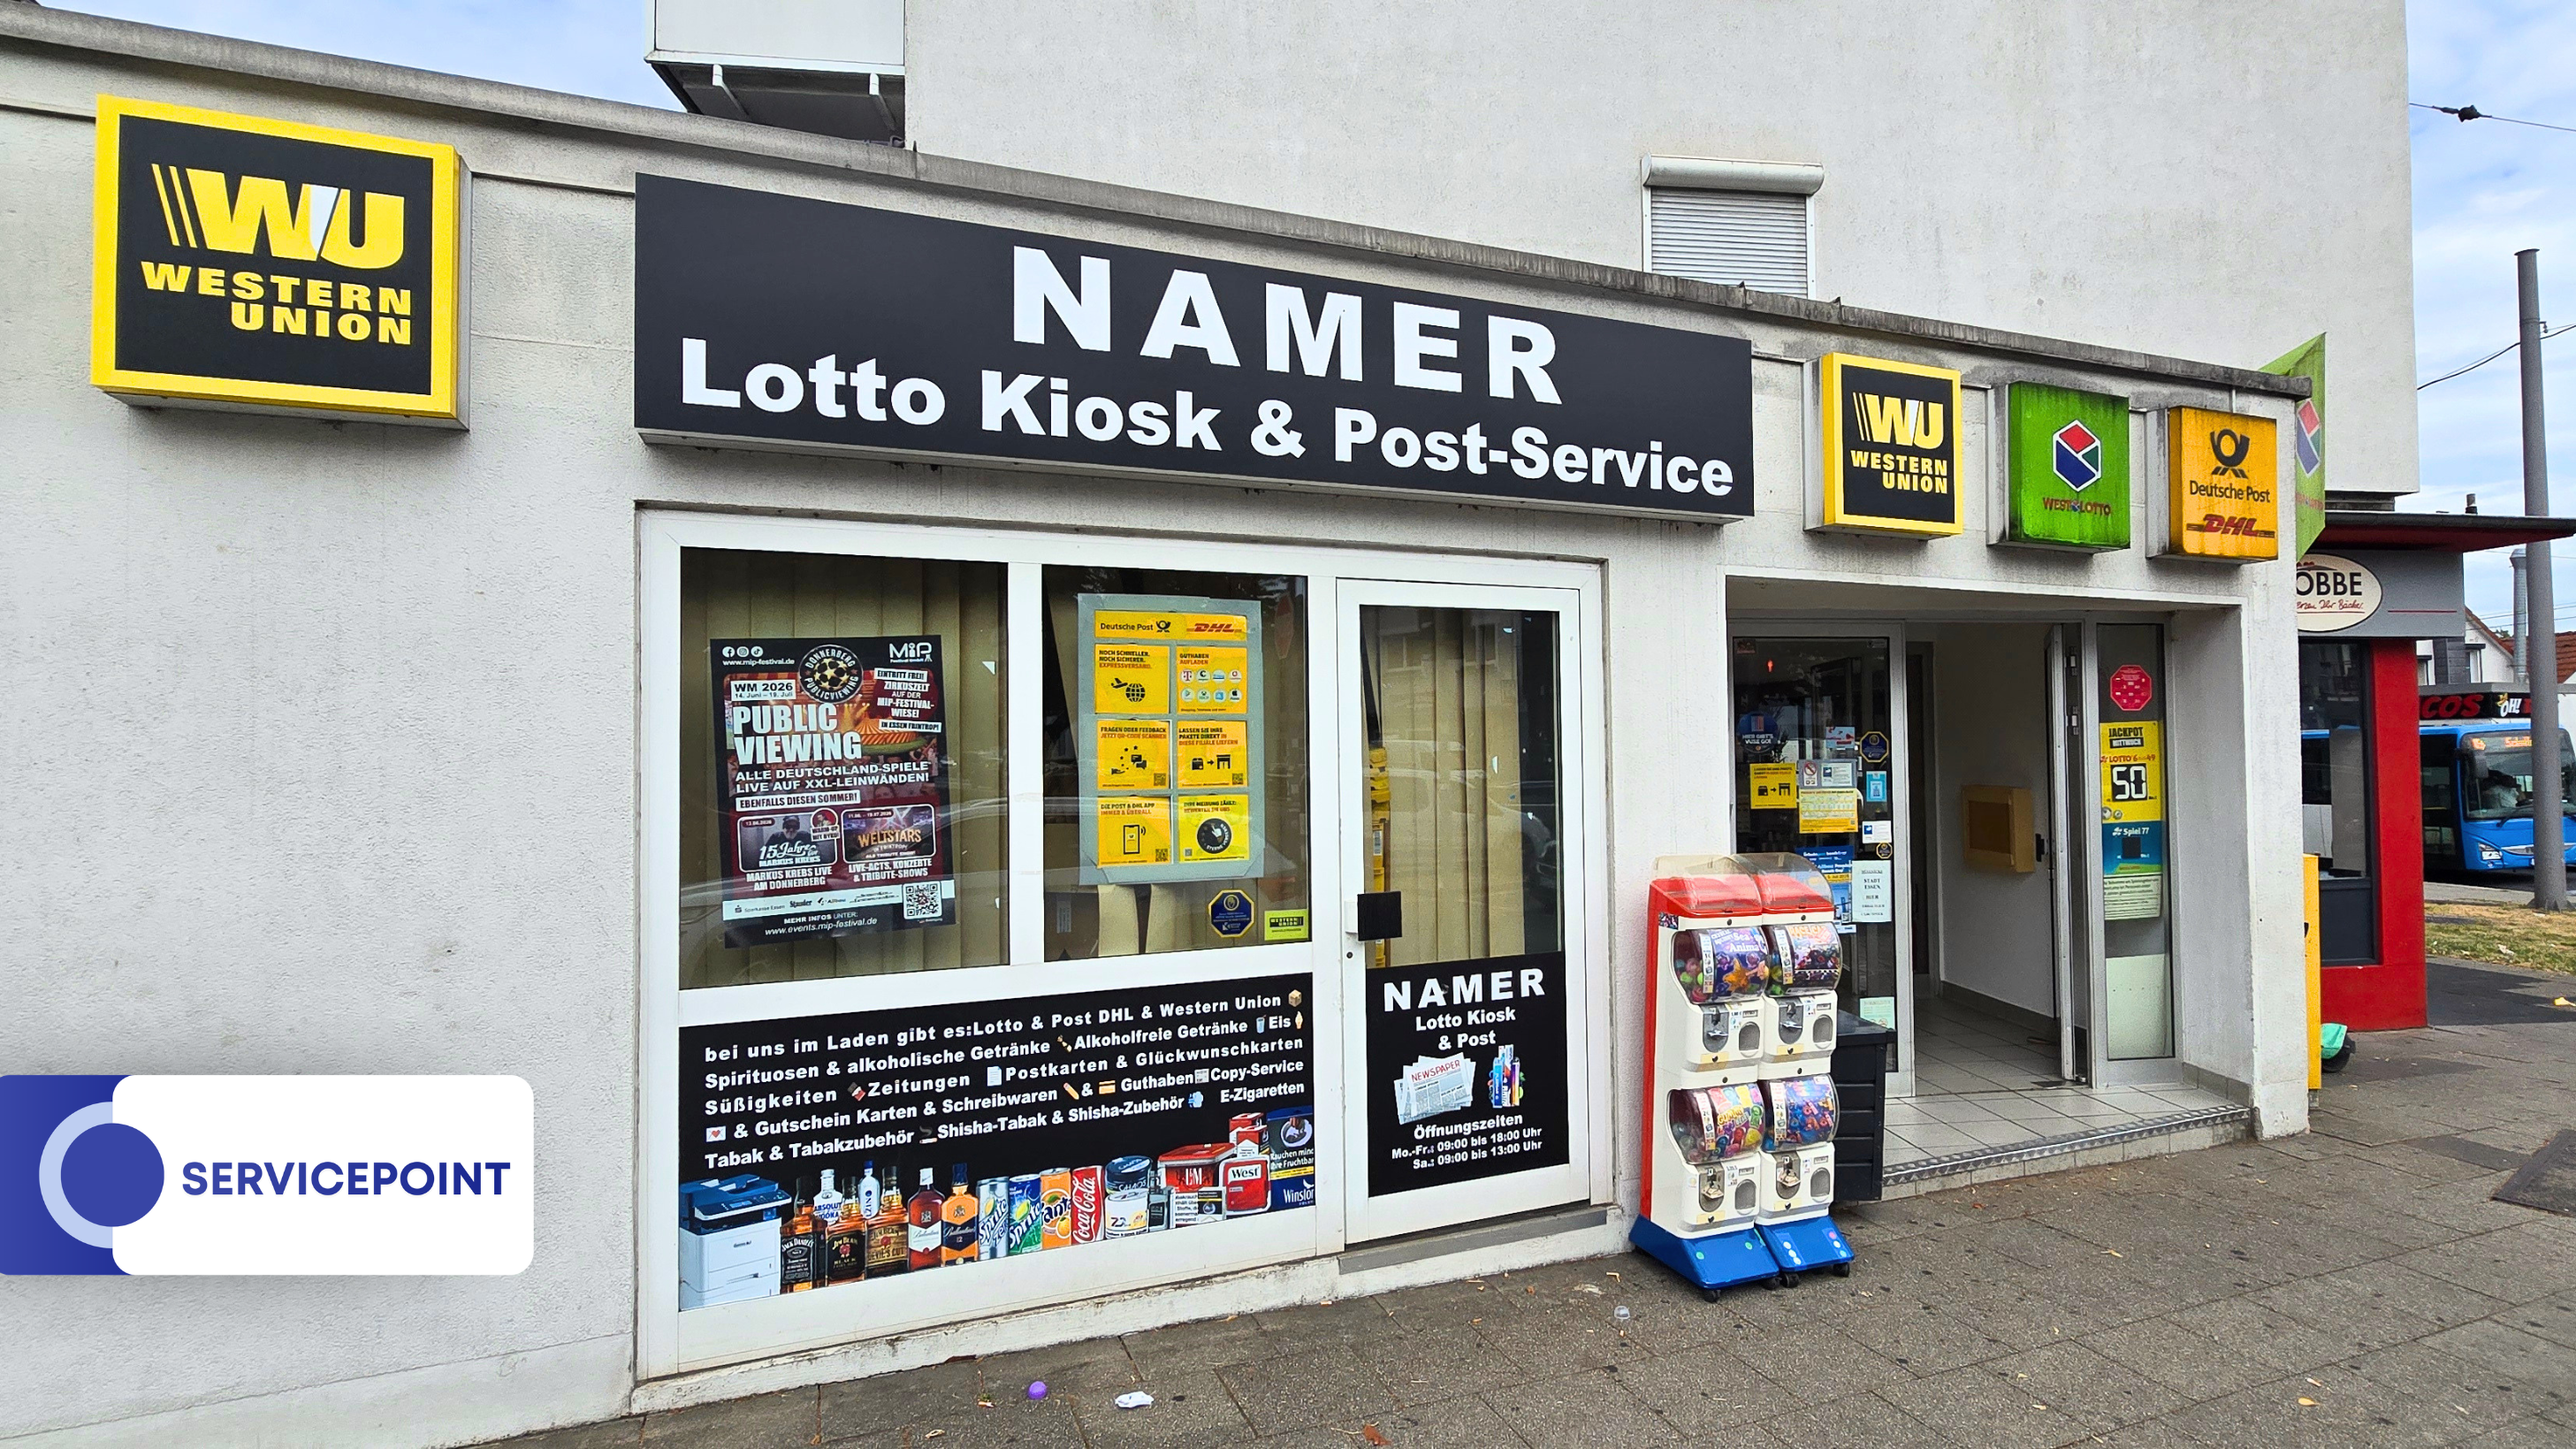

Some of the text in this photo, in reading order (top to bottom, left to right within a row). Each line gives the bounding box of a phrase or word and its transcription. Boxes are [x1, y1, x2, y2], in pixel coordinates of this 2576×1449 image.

[184, 167, 405, 270] WU
[141, 260, 412, 316] WESTERN
[231, 301, 412, 346] UNION
[1013, 245, 1563, 405] NAMER
[682, 337, 1734, 497] Lotto Kiosk & Post-Service
[1863, 393, 1944, 450] WU
[1850, 450, 1948, 477] WESTERN
[1882, 470, 1948, 495] UNION
[2189, 479, 2271, 504] Deutsche Post
[2202, 513, 2259, 537] DHL
[1193, 622, 1235, 633] DHL
[721, 658, 796, 667] www.mip-festival.de
[804, 648, 857, 669] DONNERBERG
[734, 683, 794, 692] WM 2026
[883, 680, 931, 692] ZIRKUSZELT
[732, 703, 837, 736] PUBLIC
[2499, 698, 2523, 718] OH!
[2108, 726, 2144, 738] JACKPOT
[733, 731, 863, 766] VIEWING
[735, 761, 930, 782] ALLE DEUTSCHLAND-SPIELE
[736, 772, 930, 794] LIVE AUF XXL-LEINWÄNDEN!
[2112, 765, 2146, 800] 50
[739, 792, 857, 809] EBENFALLS DIESEN SOMMER!
[857, 828, 922, 849] WELTSTARS
[2123, 827, 2141, 836] Spiel
[758, 843, 779, 860] 15
[892, 858, 933, 869] KONZERTE
[746, 866, 833, 882] MARKUS KREBS LIVE
[753, 876, 827, 891] AM DONNERBERG
[861, 867, 929, 881] TRIBUTE-SHOWS
[764, 917, 878, 936] www.events.mip-festival.de
[783, 915, 807, 925] MEHR
[808, 913, 832, 922] INFOS
[1383, 967, 1546, 1012] NAMER
[705, 995, 1282, 1063] bei uns im Laden gibt & Post DHL & Western Union
[1415, 1006, 1517, 1032] Lotto Kiosk
[1437, 1030, 1497, 1050] & Post
[705, 1015, 1292, 1092] Spirituosen & alkoholische Getränke Alkoholfreie Getränke Eis
[705, 1037, 1304, 1117] Süßigkeiten Zeitungen Postkarten & Glückwunschkarten
[1411, 1059, 1461, 1083] NEWSPAPER
[734, 1059, 1304, 1139] & Gutschein Karten & Schreibwaren & Guthaben Copy-Service
[705, 1080, 1305, 1170] Tabak & Tabakzubehör Shisha-Tabak & Shisha-Zubehör E-Zigaretten
[1414, 1114, 1523, 1140] Öffnungszeiten
[1437, 1138, 1468, 1153] 09:00
[1470, 1135, 1488, 1149] bis
[1490, 1129, 1520, 1144] 18:00
[1522, 1126, 1543, 1139] Uhr
[1437, 1152, 1469, 1166] 09:00
[1471, 1148, 1488, 1161] bis
[1490, 1143, 1520, 1156] 13:00
[1522, 1140, 1543, 1151] Uhr
[1185, 1167, 1202, 1186] L&M
[1231, 1166, 1260, 1178] West
[979, 1198, 1007, 1246] Sprite
[1009, 1201, 1041, 1249] Sprite
